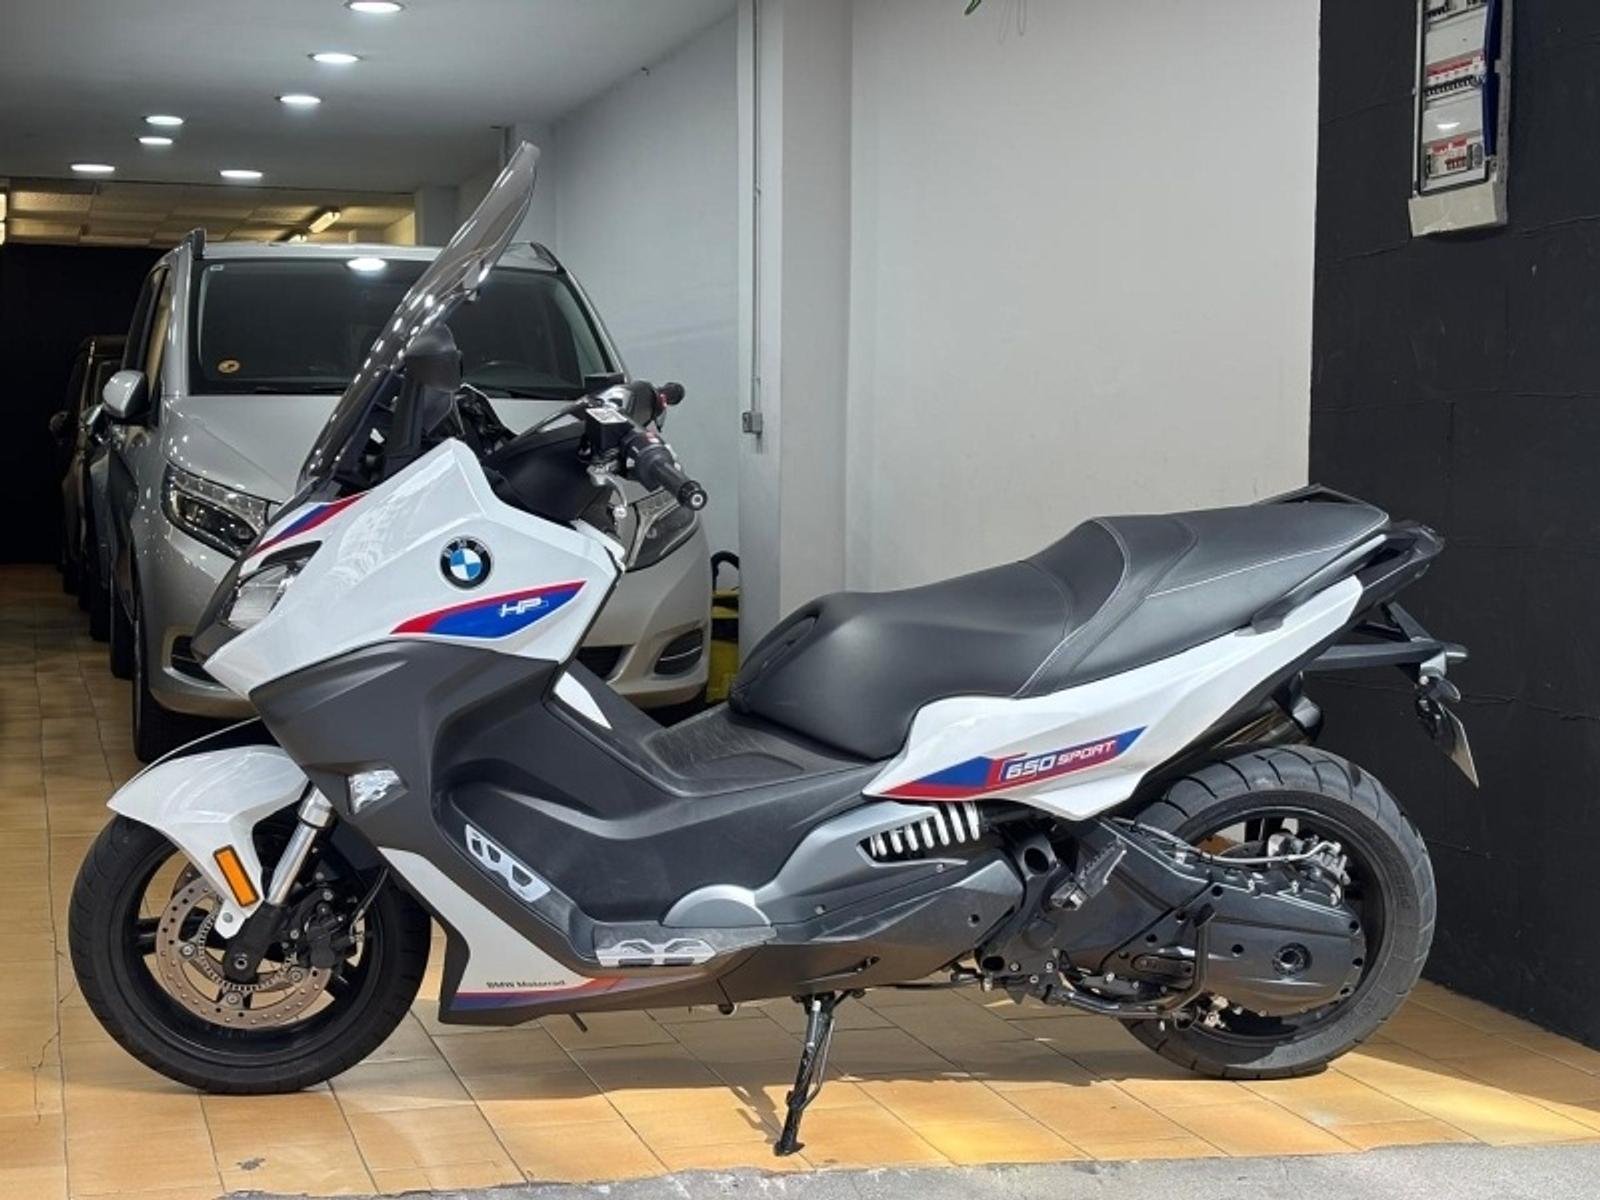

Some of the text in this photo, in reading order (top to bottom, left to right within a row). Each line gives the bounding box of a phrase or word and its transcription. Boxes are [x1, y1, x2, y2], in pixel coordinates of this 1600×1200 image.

[1005, 739, 1118, 780] 650 SPORT
[486, 979, 566, 989] BMW Motorrad
